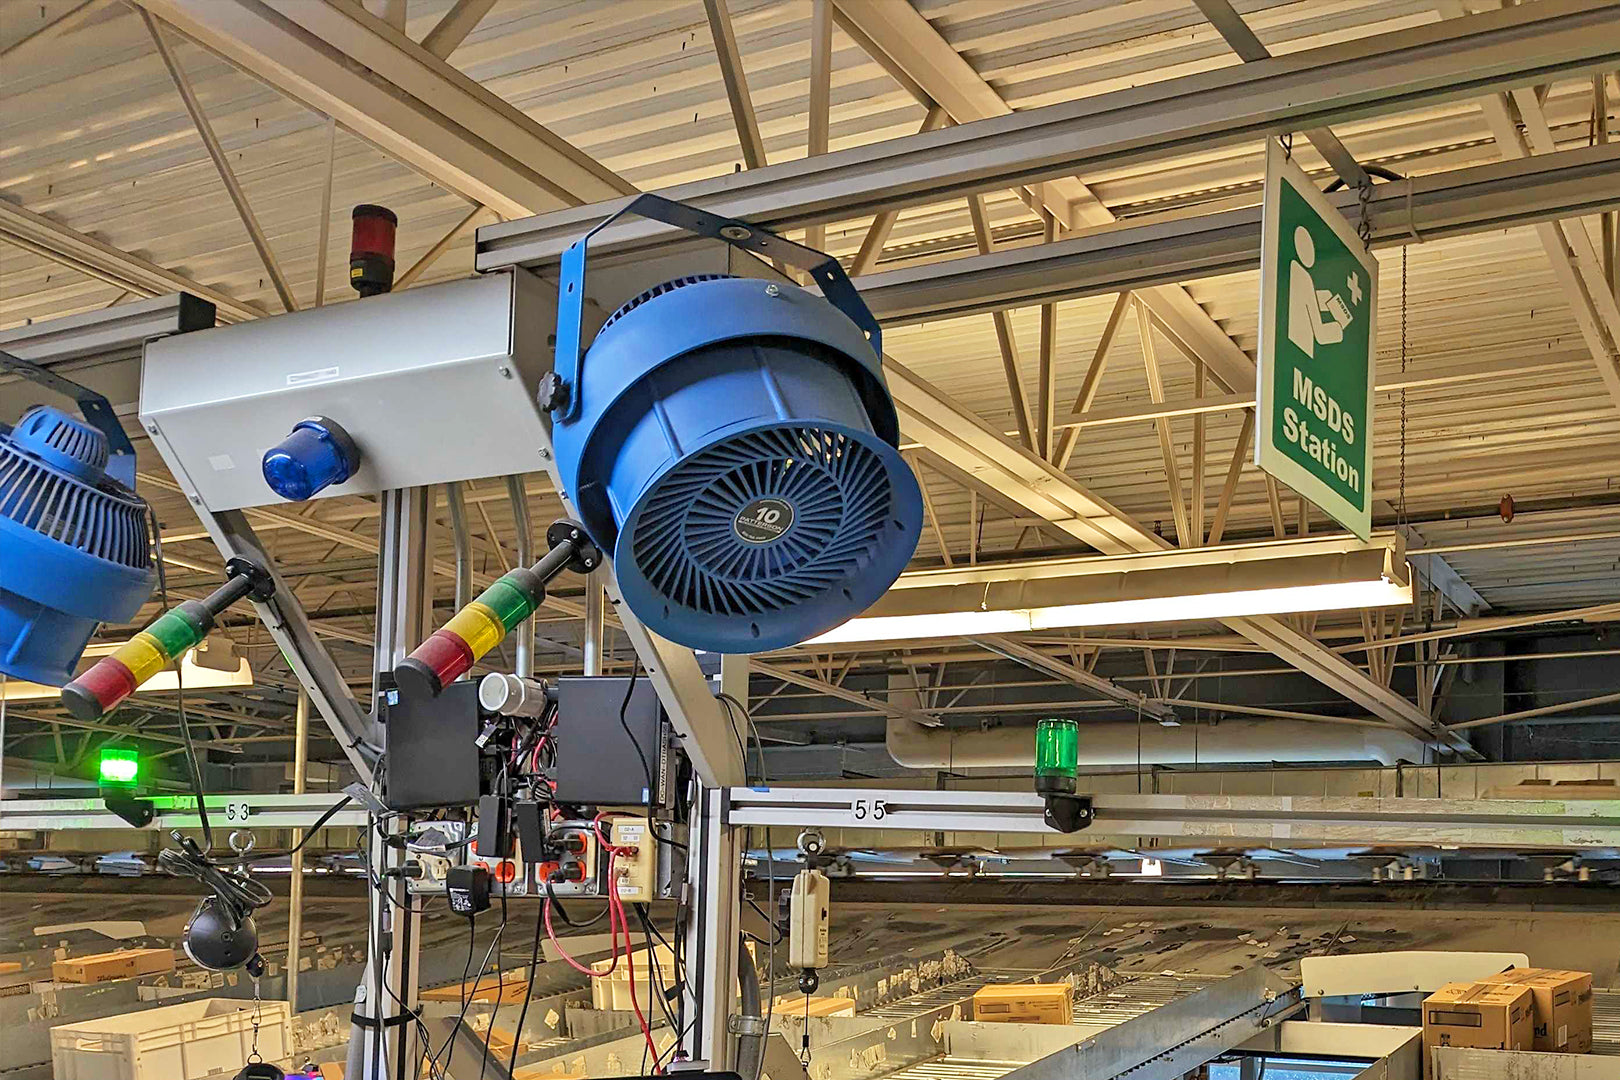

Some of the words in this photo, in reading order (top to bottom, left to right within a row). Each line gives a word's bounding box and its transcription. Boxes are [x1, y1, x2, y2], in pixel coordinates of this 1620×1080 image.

[1336, 297, 1350, 319] MSDS
[1293, 367, 1354, 445] MSDS
[1283, 407, 1359, 493] Station
[739, 516, 784, 532] PATTERSON
[757, 507, 780, 524] 10
[228, 803, 249, 820] 53
[855, 800, 885, 820] 55
